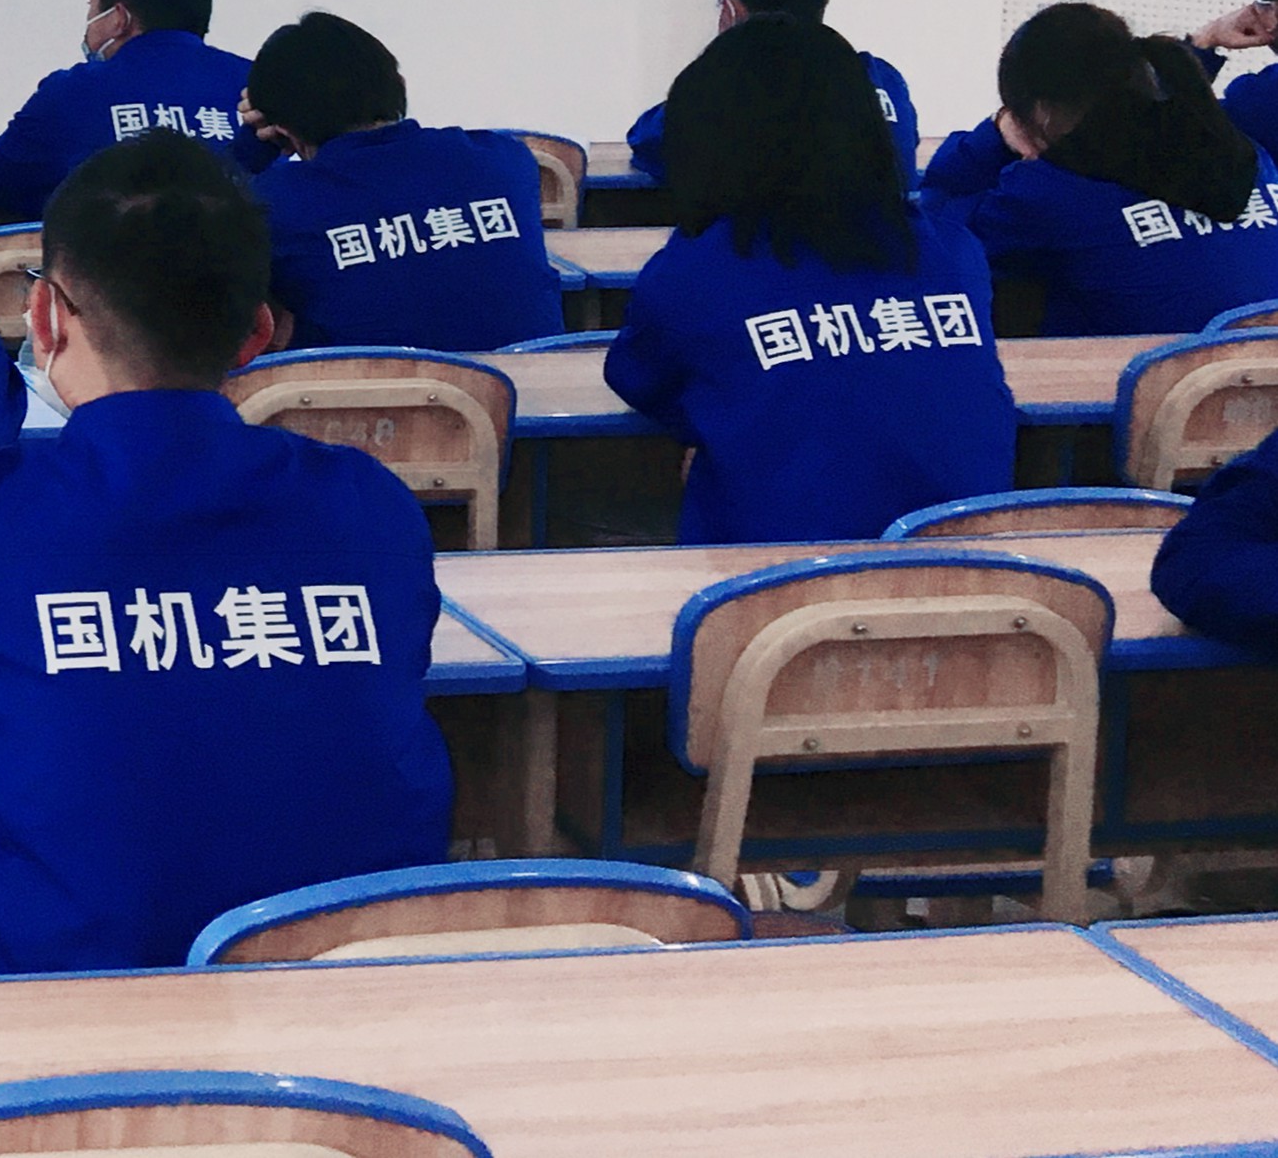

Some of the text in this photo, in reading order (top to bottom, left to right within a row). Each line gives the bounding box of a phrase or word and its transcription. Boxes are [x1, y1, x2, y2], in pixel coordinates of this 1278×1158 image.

[110, 103, 243, 141] 国机集
[326, 197, 520, 270] 国机集团
[745, 293, 983, 371] 国机集团
[35, 584, 381, 675] 国机集团
